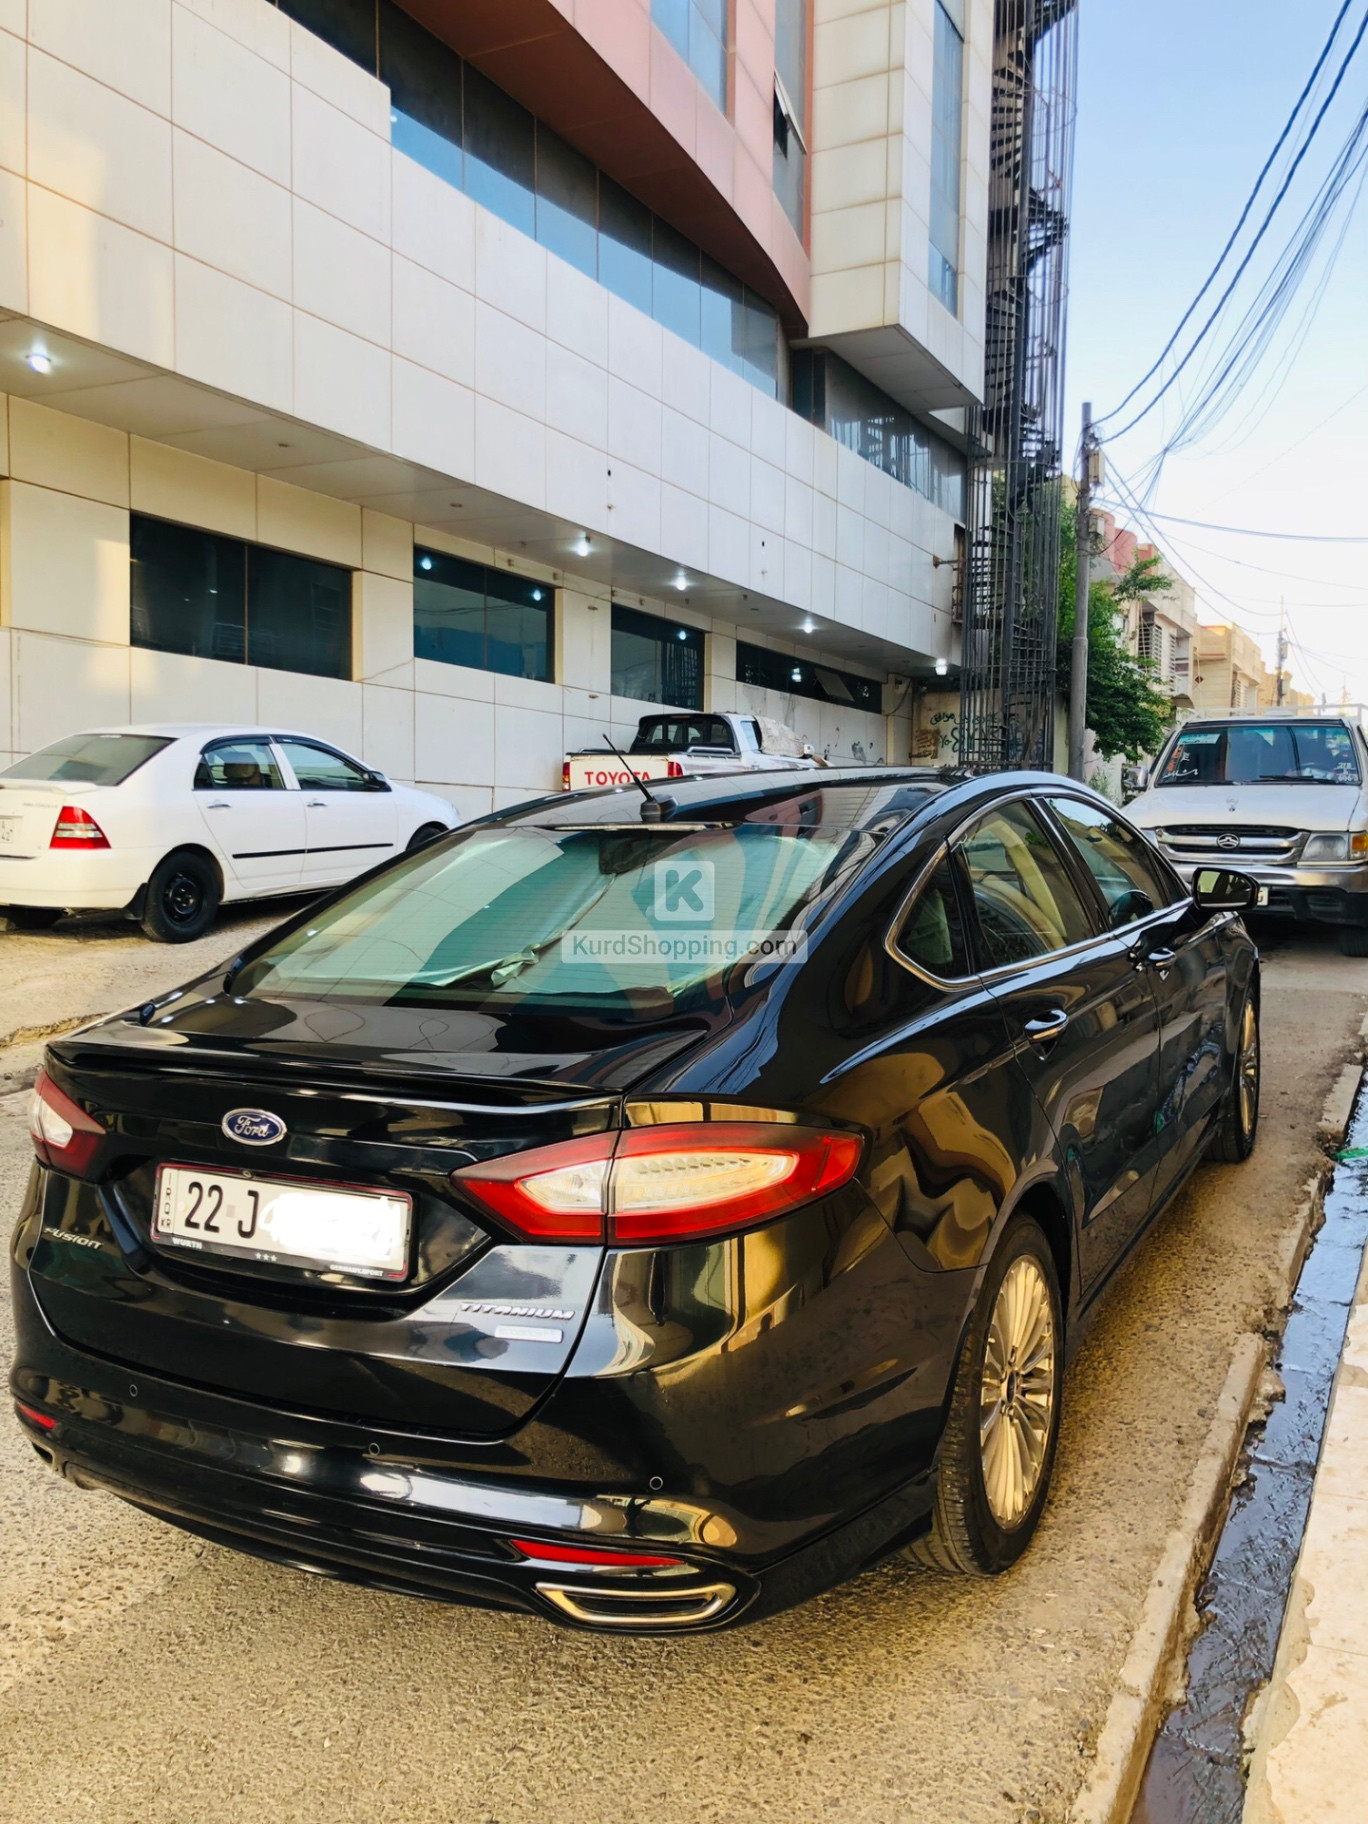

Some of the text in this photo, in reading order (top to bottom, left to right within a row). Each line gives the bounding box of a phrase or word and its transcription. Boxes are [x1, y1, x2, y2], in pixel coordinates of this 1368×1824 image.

[234, 1115, 271, 1137] Ford
[184, 1181, 259, 1239] 22 J
[461, 1303, 576, 1320] TITANIUM
